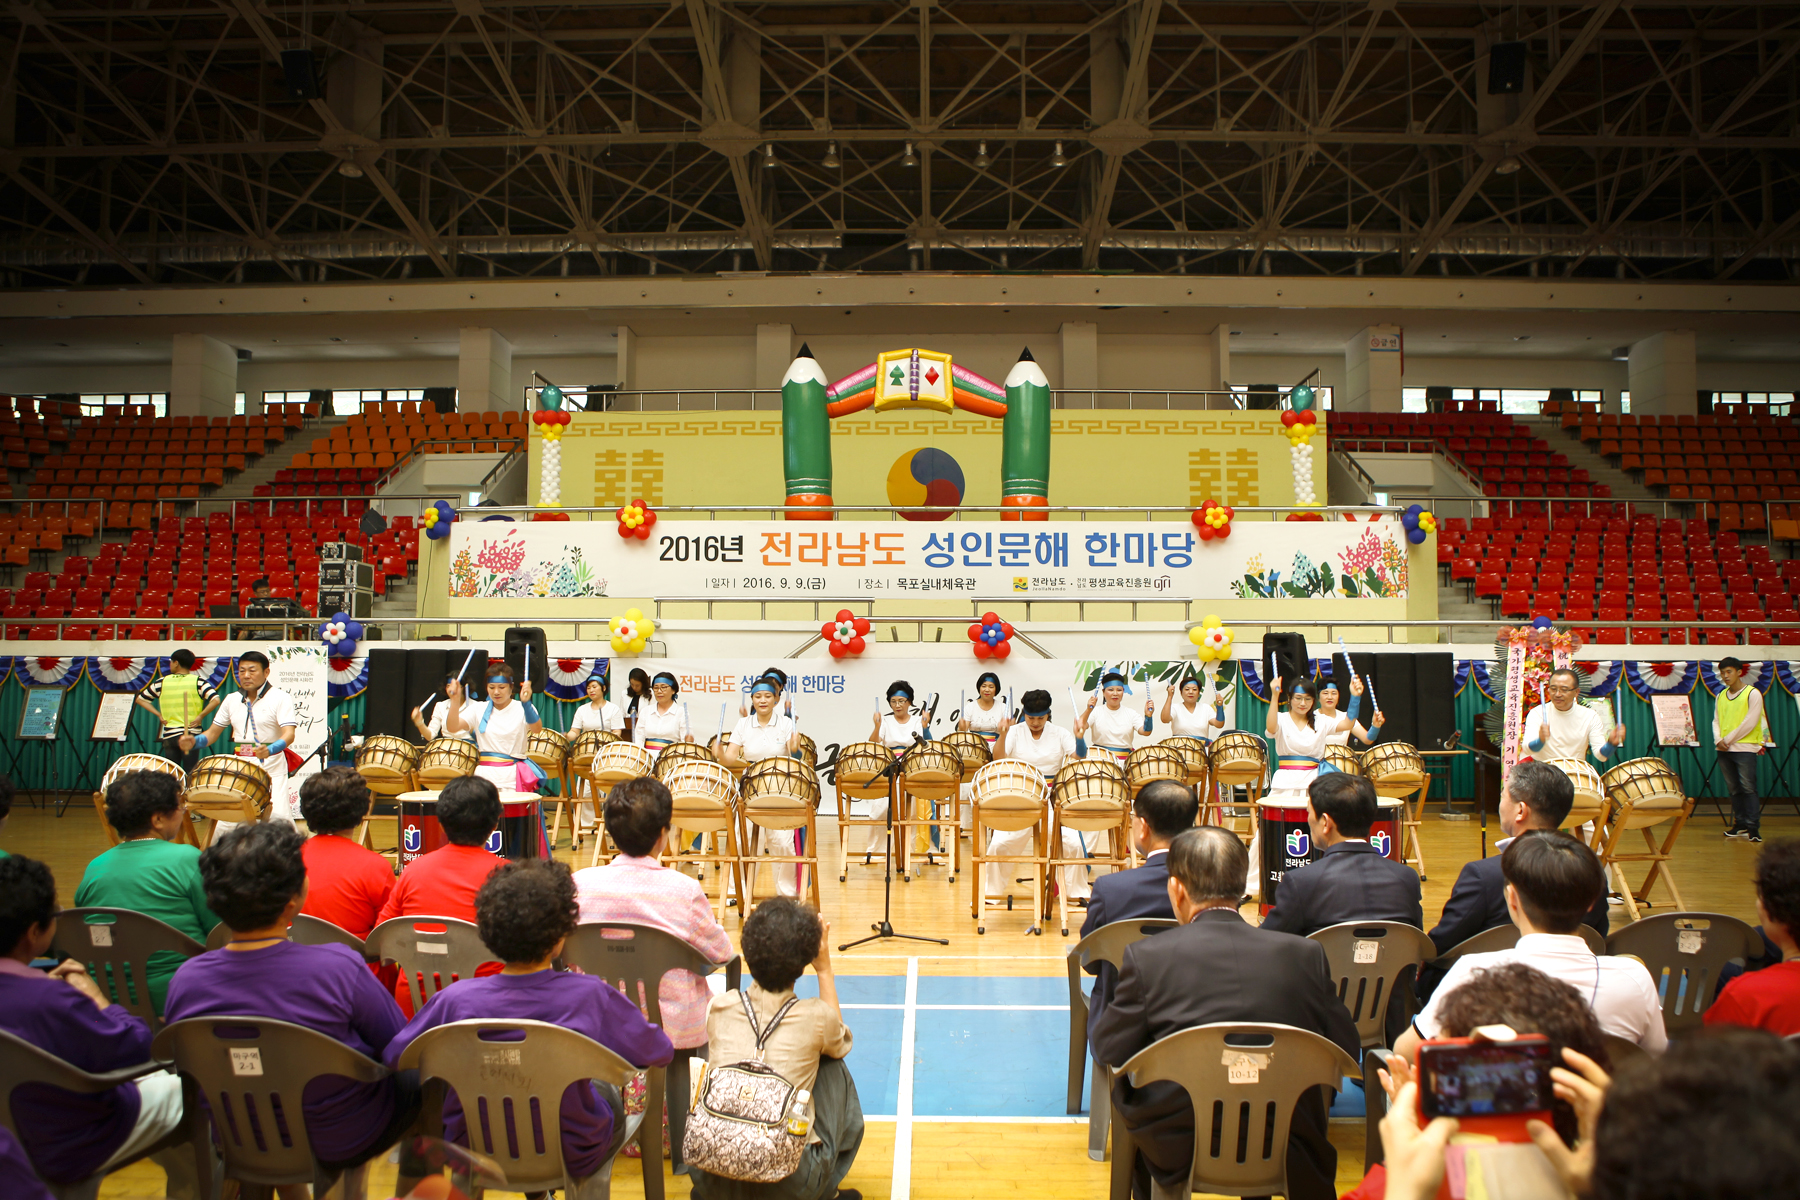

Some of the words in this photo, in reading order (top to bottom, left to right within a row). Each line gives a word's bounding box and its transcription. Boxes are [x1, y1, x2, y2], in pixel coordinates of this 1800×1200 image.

[658, 535, 744, 564] 2016년
[759, 531, 906, 567] 전라남도
[921, 531, 1069, 568] 성인문해
[1083, 531, 1196, 568] 한마당
[742, 577, 775, 590] 2016.
[780, 577, 790, 590] 9.
[896, 577, 977, 591] 목포실내체육관
[1031, 577, 1067, 586] 전라남도
[1088, 577, 1152, 588] 평생교육진흥원
[679, 675, 736, 694] 전라남도
[740, 675, 798, 694] 성해
[801, 675, 846, 694] 한마당
[1506, 647, 1522, 741] 국가평생교육진흥원장
[1230, 1070, 1258, 1079] 10-12
